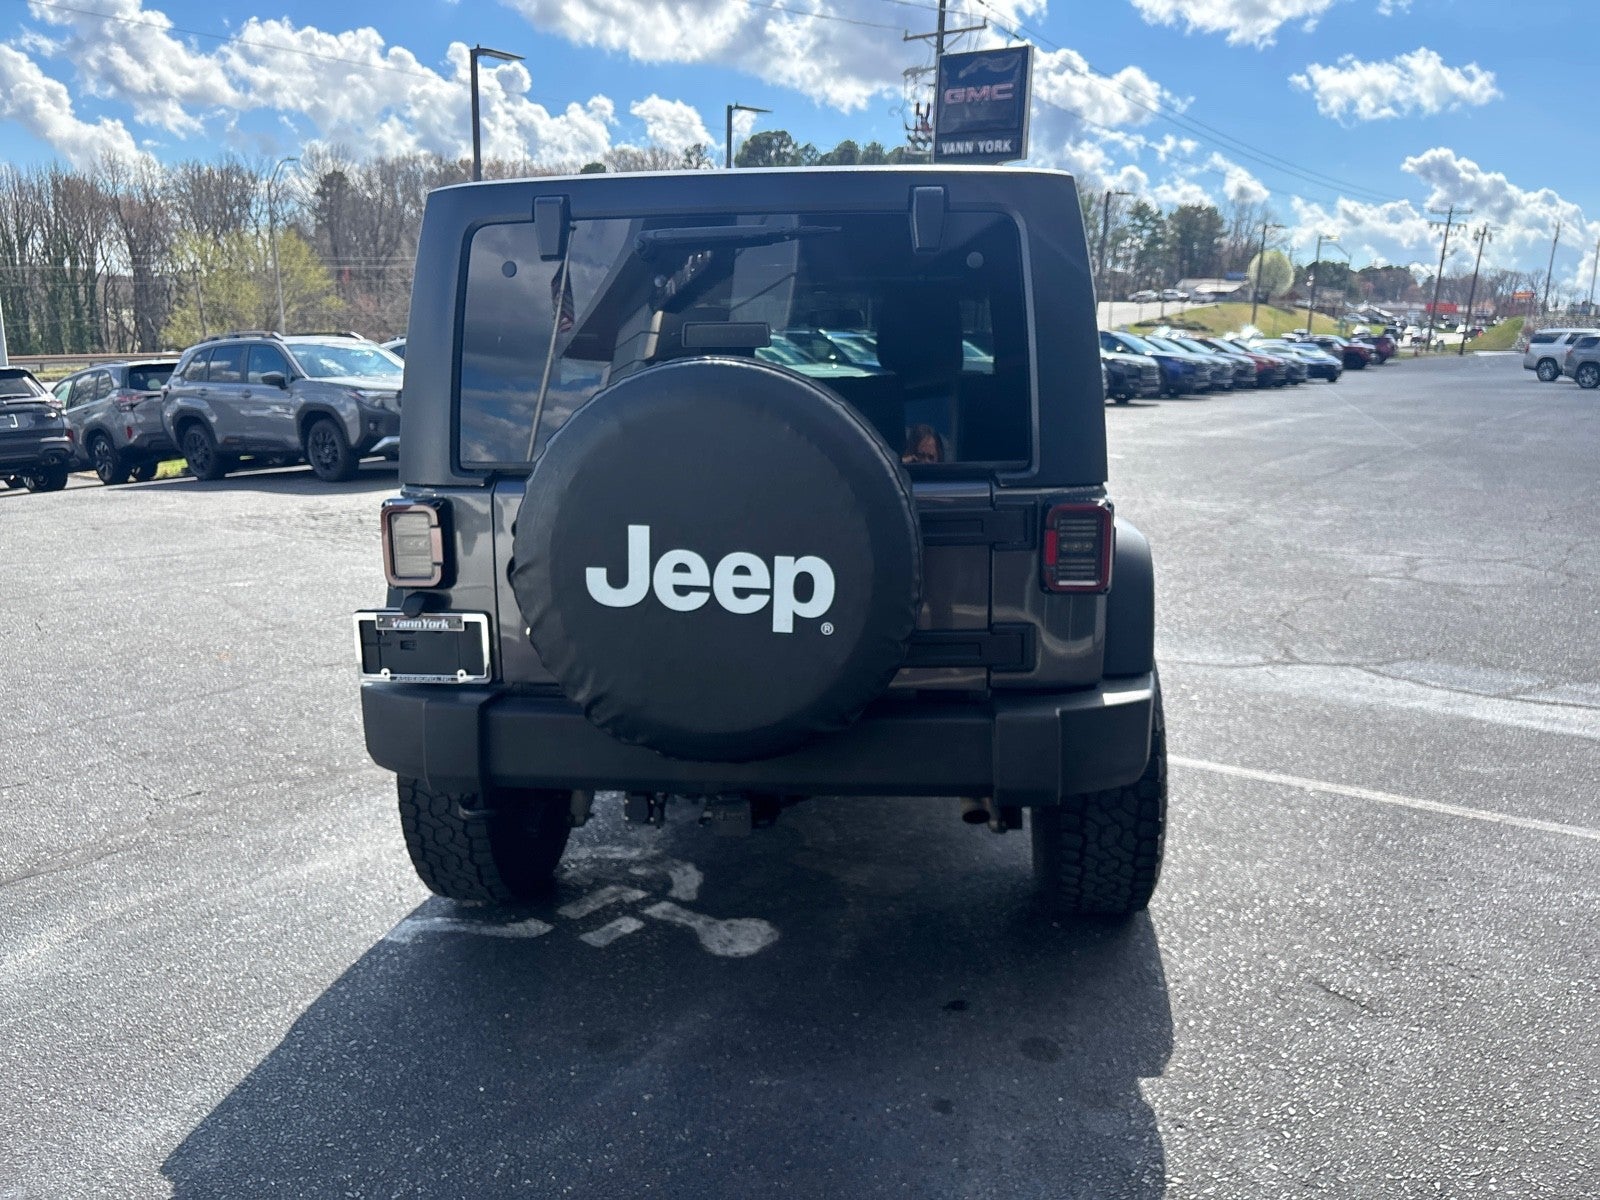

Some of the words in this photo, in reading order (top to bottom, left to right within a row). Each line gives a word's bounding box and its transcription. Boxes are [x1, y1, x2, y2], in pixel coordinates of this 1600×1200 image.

[944, 83, 1014, 104] GMC
[941, 140, 974, 155] VANN
[978, 139, 1012, 153] YORK
[585, 524, 836, 634] Jeep
